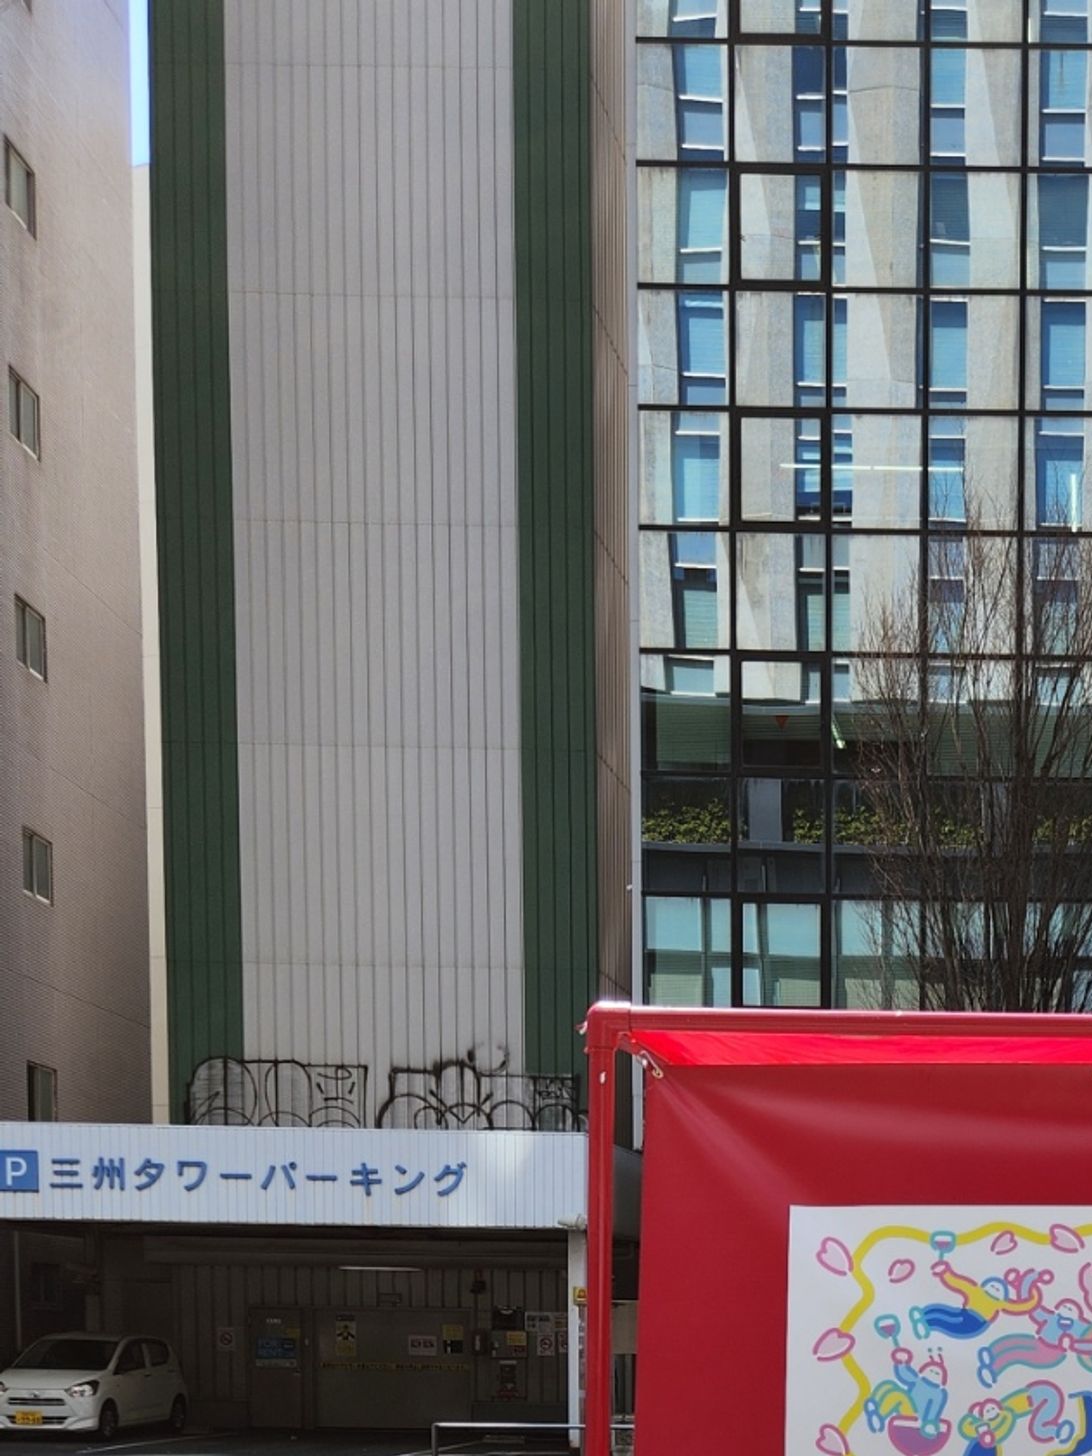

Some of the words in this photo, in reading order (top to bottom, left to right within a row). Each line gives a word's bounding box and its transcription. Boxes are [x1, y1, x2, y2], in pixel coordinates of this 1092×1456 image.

[5, 1157, 27, 1187] P
[49, 1156, 467, 1198] 三州タワーパーキング
